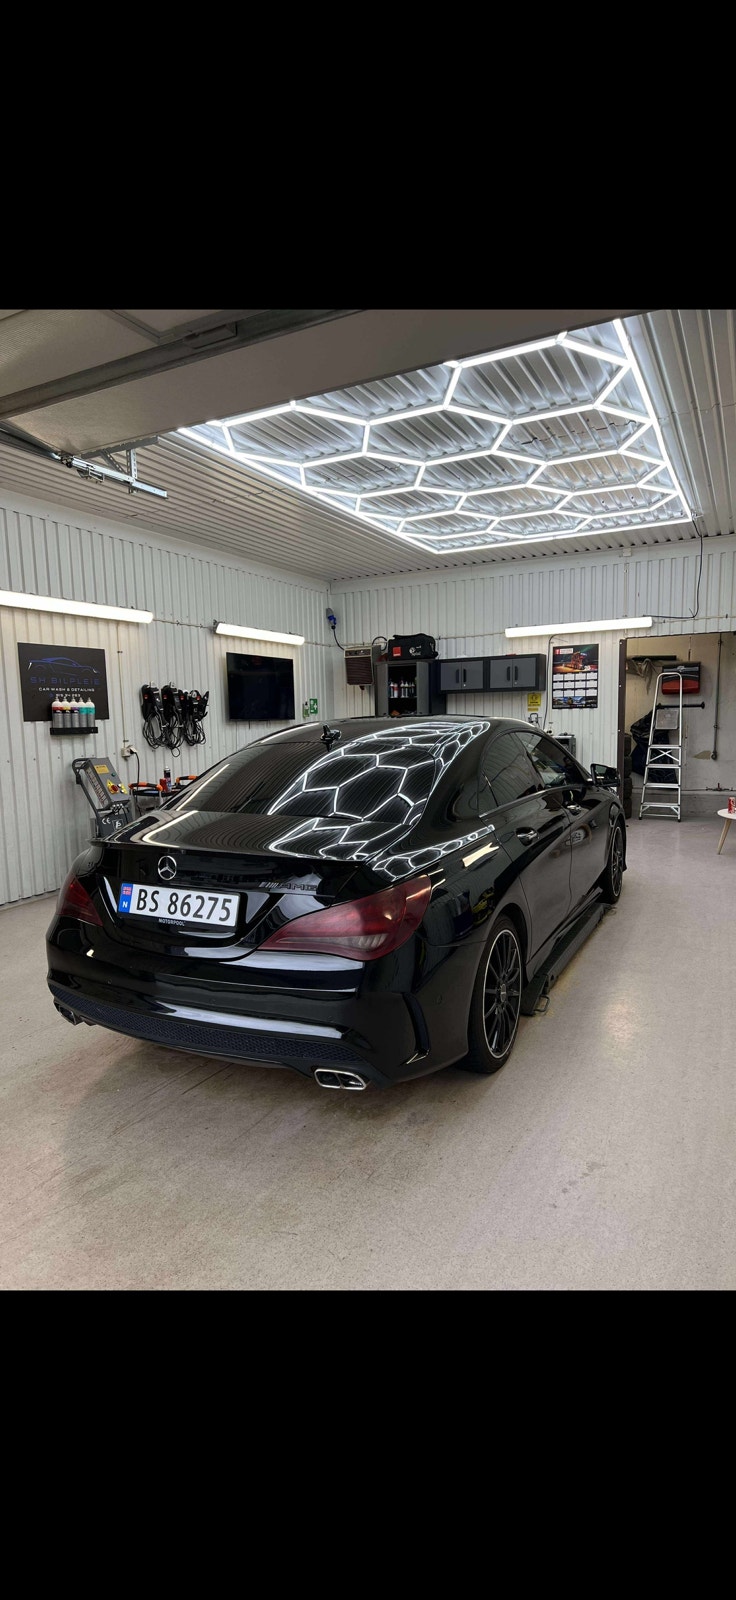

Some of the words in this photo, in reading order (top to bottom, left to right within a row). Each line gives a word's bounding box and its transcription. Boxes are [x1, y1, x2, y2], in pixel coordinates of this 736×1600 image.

[30, 676, 46, 684] SH
[50, 677, 100, 686] BILPLEIE
[136, 888, 160, 913] BS
[167, 892, 232, 922] 86275
[158, 918, 185, 926] MOTORPOOL
